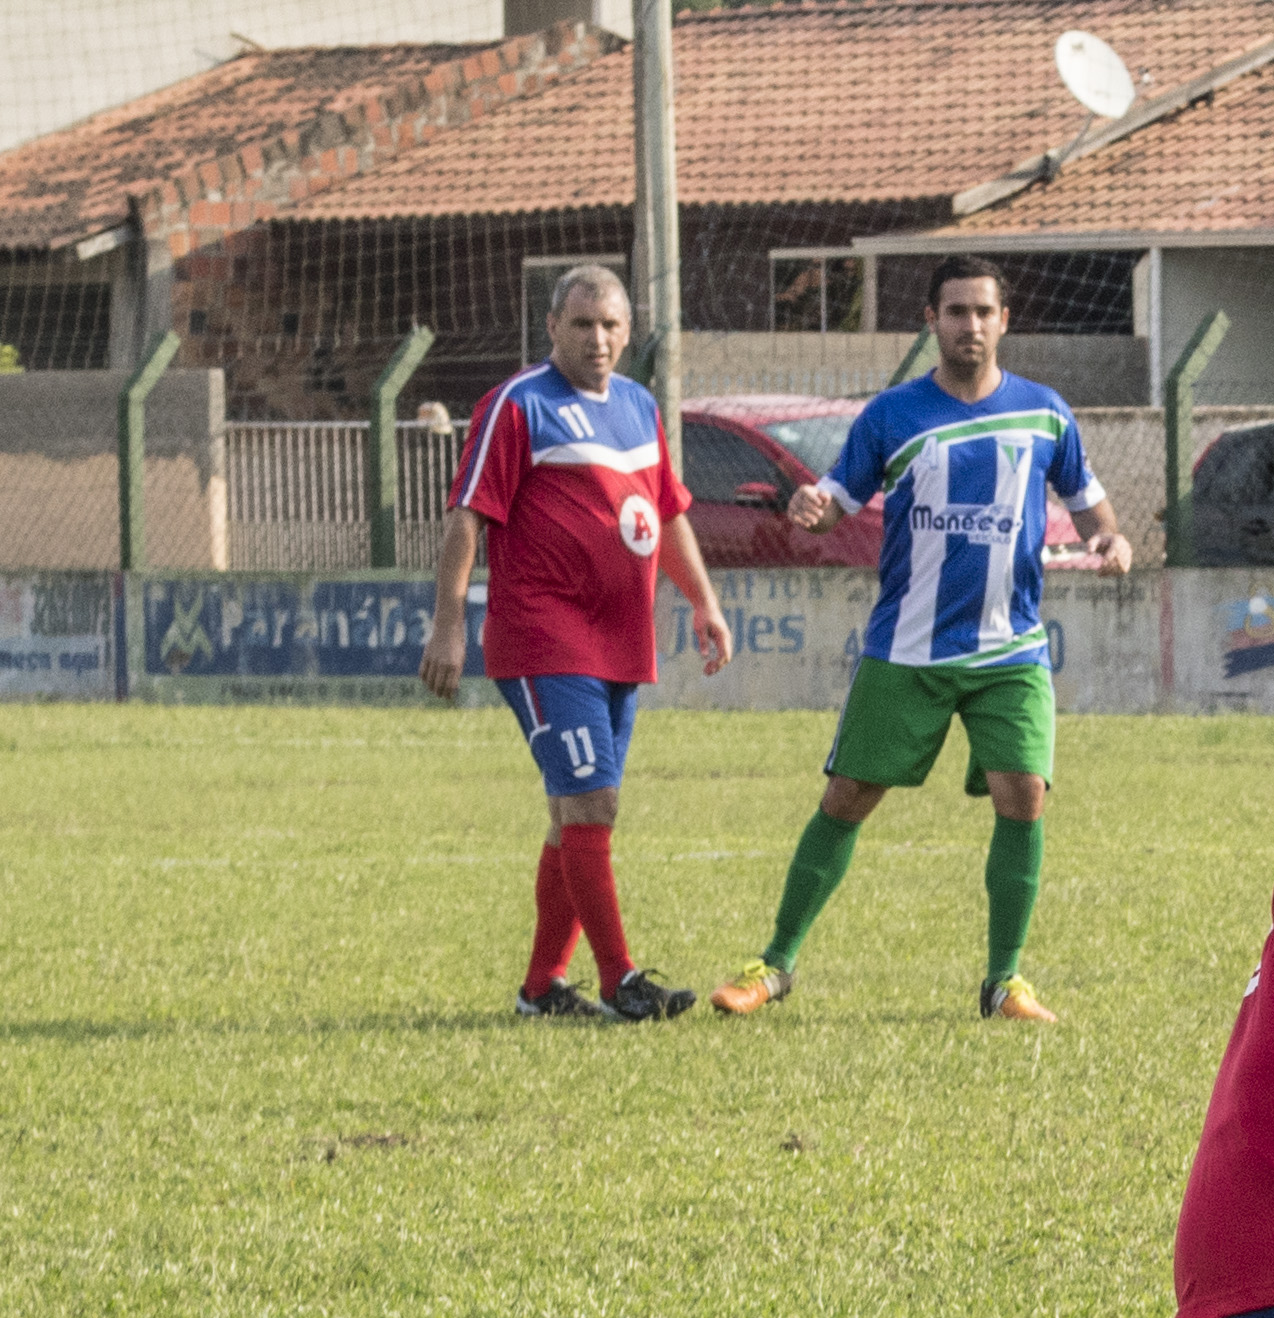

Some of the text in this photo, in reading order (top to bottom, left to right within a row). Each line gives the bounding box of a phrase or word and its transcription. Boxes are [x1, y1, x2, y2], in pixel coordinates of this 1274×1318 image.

[557, 403, 596, 440] 11
[632, 510, 654, 543] A
[560, 725, 597, 768] 11
